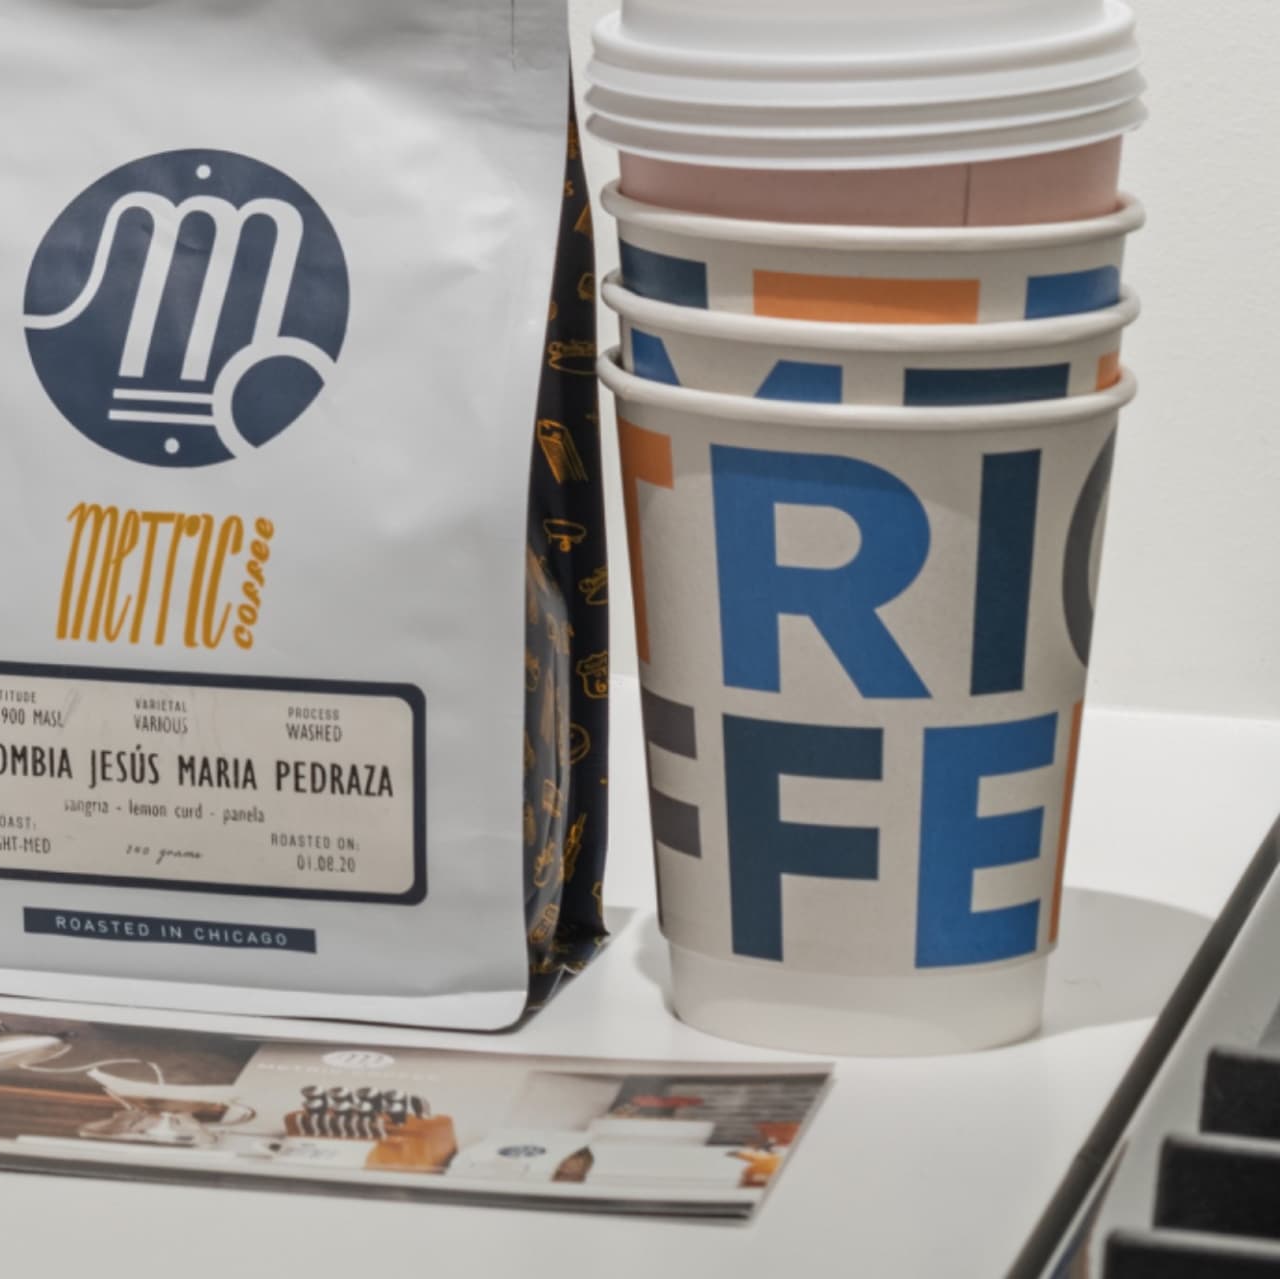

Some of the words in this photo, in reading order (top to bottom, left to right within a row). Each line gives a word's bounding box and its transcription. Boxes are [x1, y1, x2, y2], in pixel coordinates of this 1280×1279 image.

[134, 698, 188, 713] VARIETAL
[287, 706, 340, 721] PROCESS
[33, 708, 65, 728] MASL
[133, 715, 188, 735] VARIOUS
[286, 722, 343, 743] WASHED
[88, 744, 160, 789] JESÚS
[178, 754, 258, 791] MARIA
[276, 760, 394, 798] PEDRAZA
[64, 799, 109, 817] sangria
[129, 799, 167, 818] lemon
[175, 802, 203, 819] curd
[223, 806, 265, 824] panela
[271, 832, 331, 849] ROASTED
[55, 915, 150, 937] ROASTED
[161, 925, 183, 939] IN
[193, 926, 288, 946] CHICAGO
